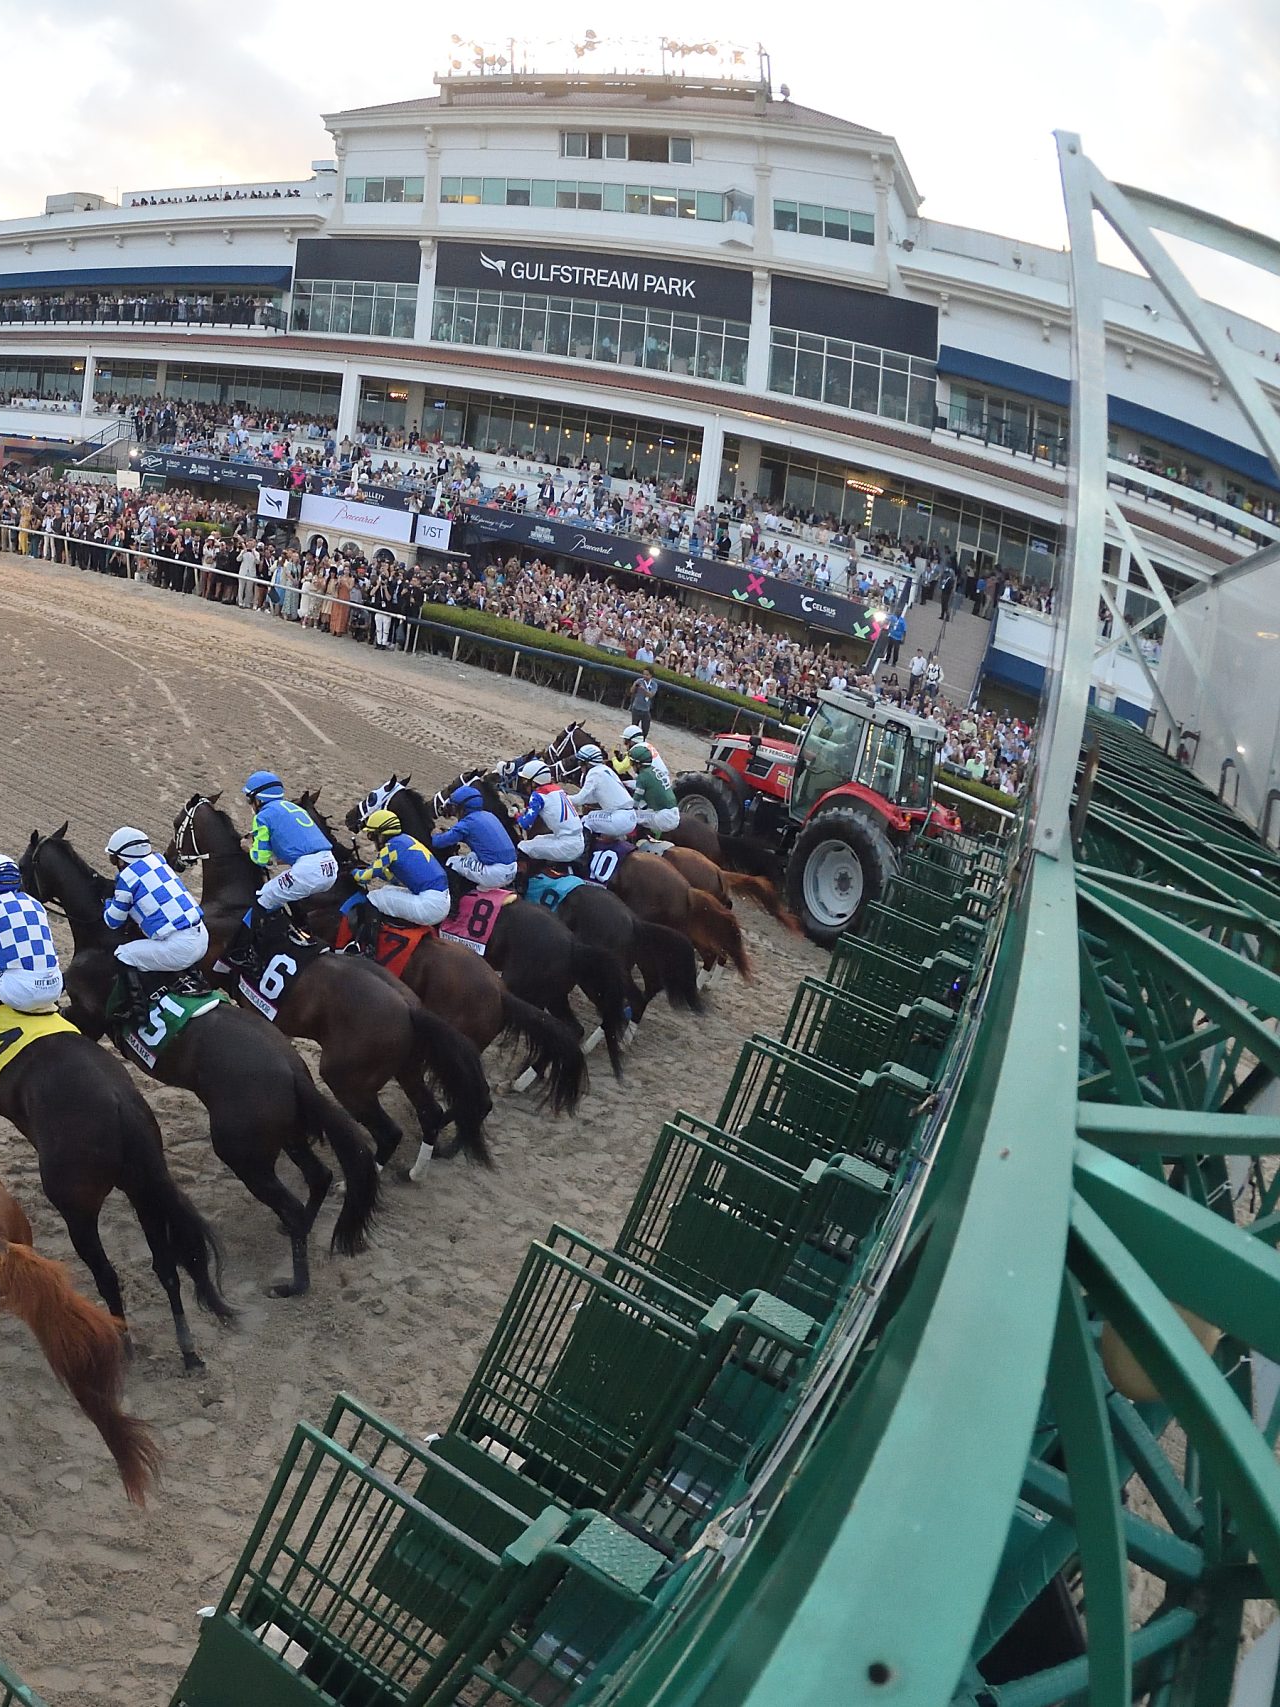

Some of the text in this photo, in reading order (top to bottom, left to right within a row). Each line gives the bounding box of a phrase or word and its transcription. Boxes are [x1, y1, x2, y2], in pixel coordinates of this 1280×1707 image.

[510, 261, 696, 298] GULFSTREAM PARK
[332, 502, 381, 525] Baccarat
[422, 525, 444, 539] 1/ST
[570, 534, 614, 556] Baccarat
[675, 565, 702, 579] Heineken
[677, 573, 698, 583] SILVER
[812, 602, 837, 616] CELSIUS
[589, 849, 619, 883] 10
[468, 898, 495, 938] 8
[379, 931, 410, 967] 7
[259, 953, 298, 1000] 6
[137, 995, 186, 1047] 5
